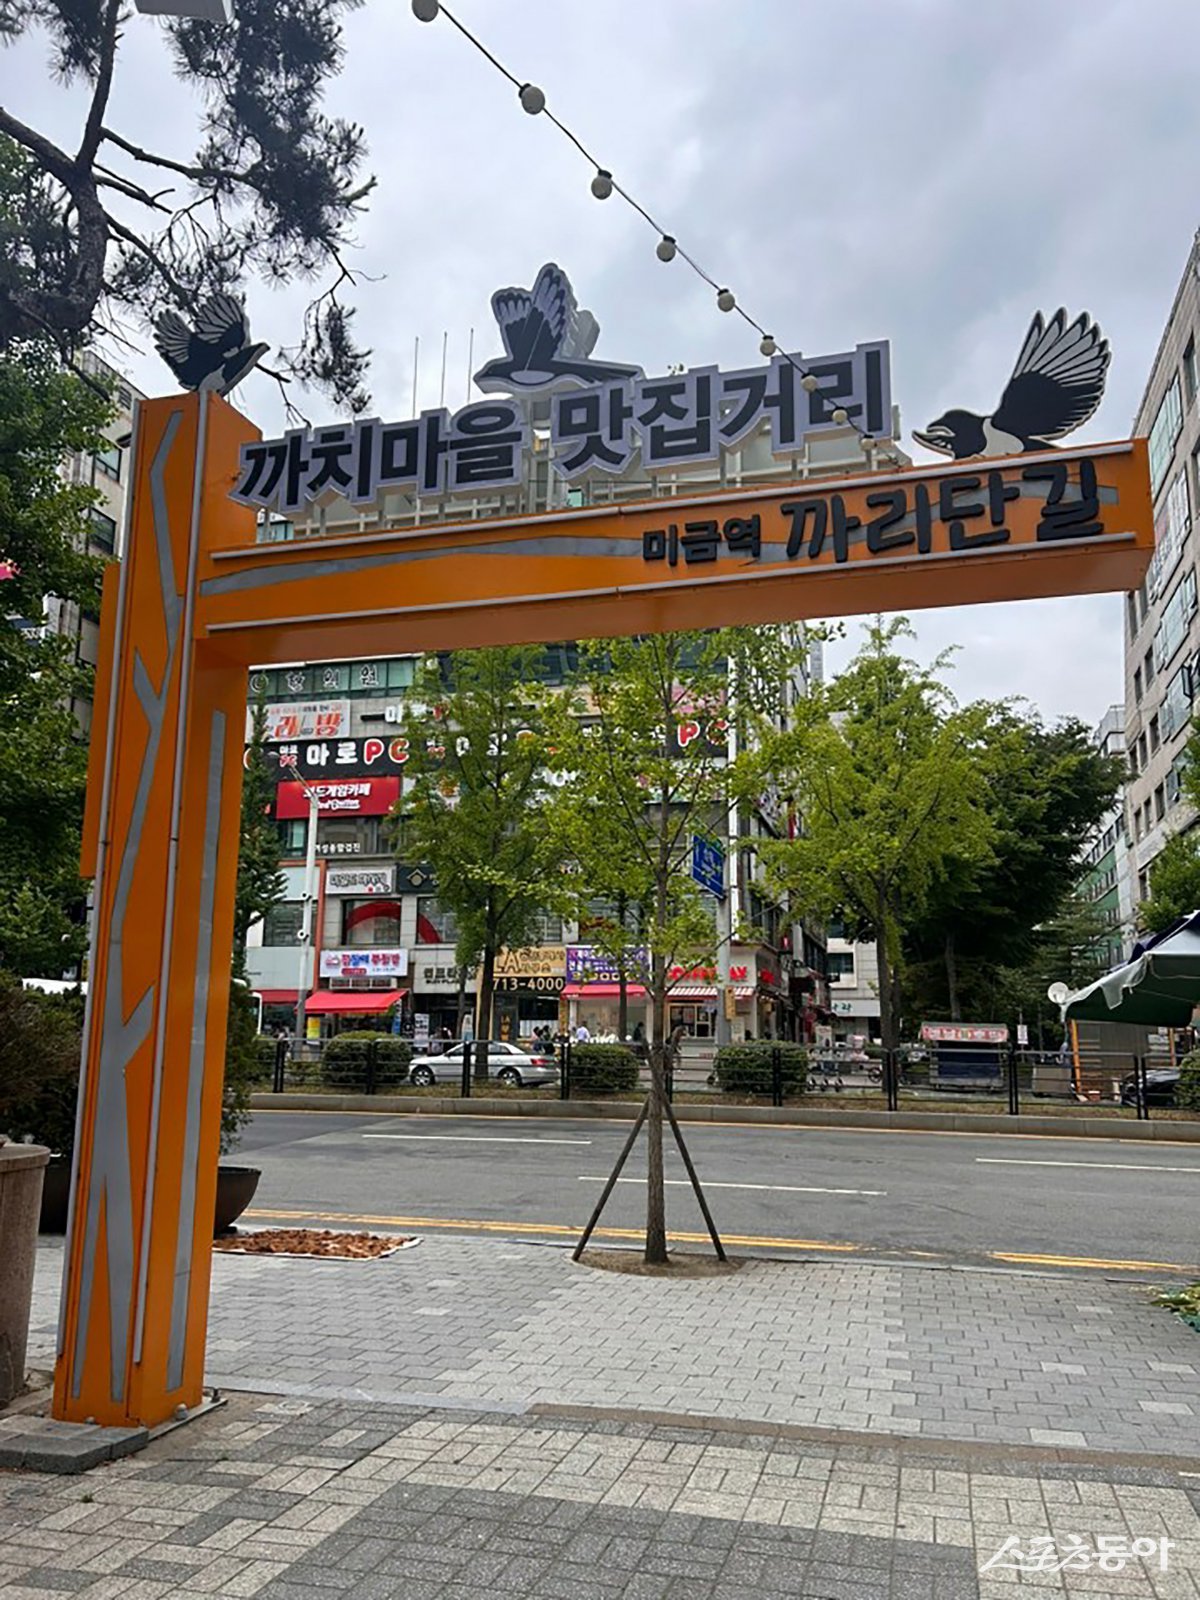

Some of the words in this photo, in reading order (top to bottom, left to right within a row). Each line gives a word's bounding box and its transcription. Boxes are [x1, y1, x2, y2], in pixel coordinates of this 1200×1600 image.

[236, 403, 524, 509] 까치마을
[555, 346, 886, 475] 맛집거리
[643, 513, 761, 567] 미금역
[780, 460, 1104, 563] 까리단길
